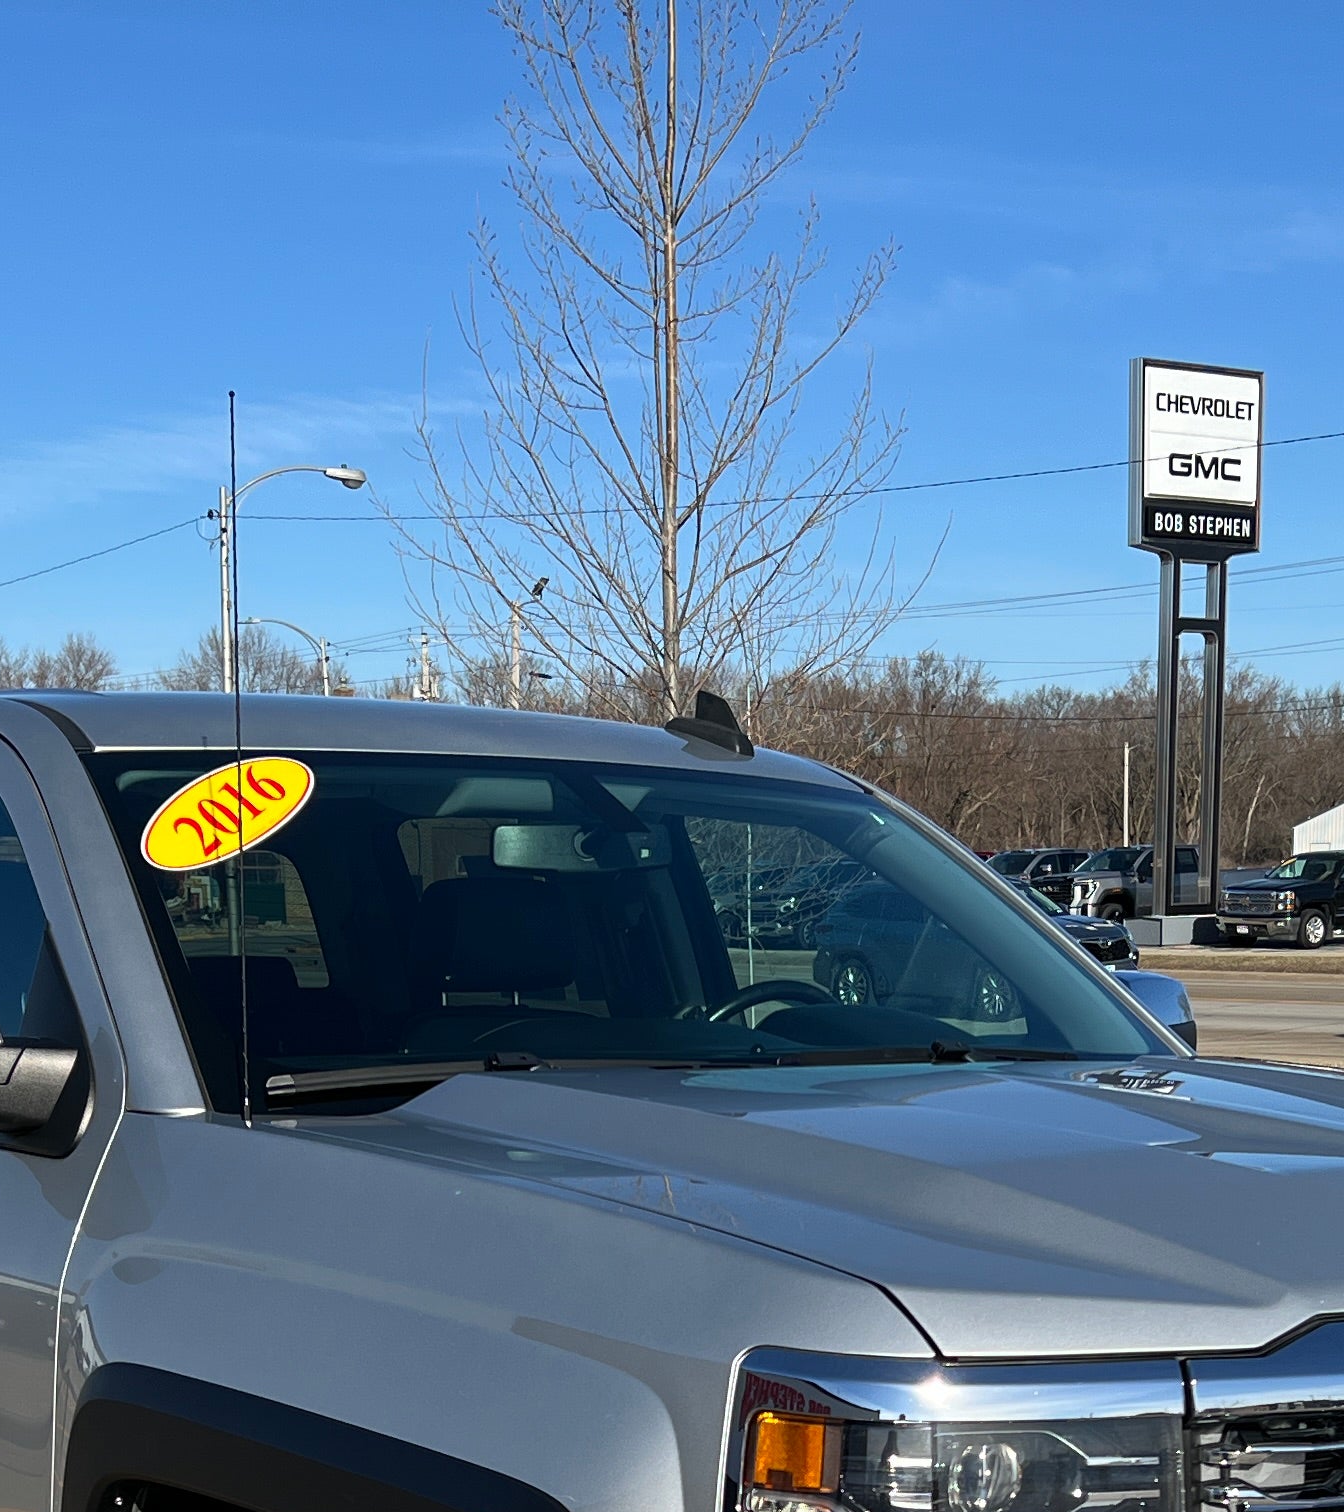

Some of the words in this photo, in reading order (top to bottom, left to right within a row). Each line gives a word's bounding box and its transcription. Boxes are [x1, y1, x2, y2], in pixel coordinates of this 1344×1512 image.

[1156, 393, 1255, 421] CHEVROLET
[1169, 453, 1242, 482] GMC
[1154, 512, 1183, 533] BOB
[1189, 515, 1251, 537] STEPHEN
[173, 765, 286, 857] 2016
